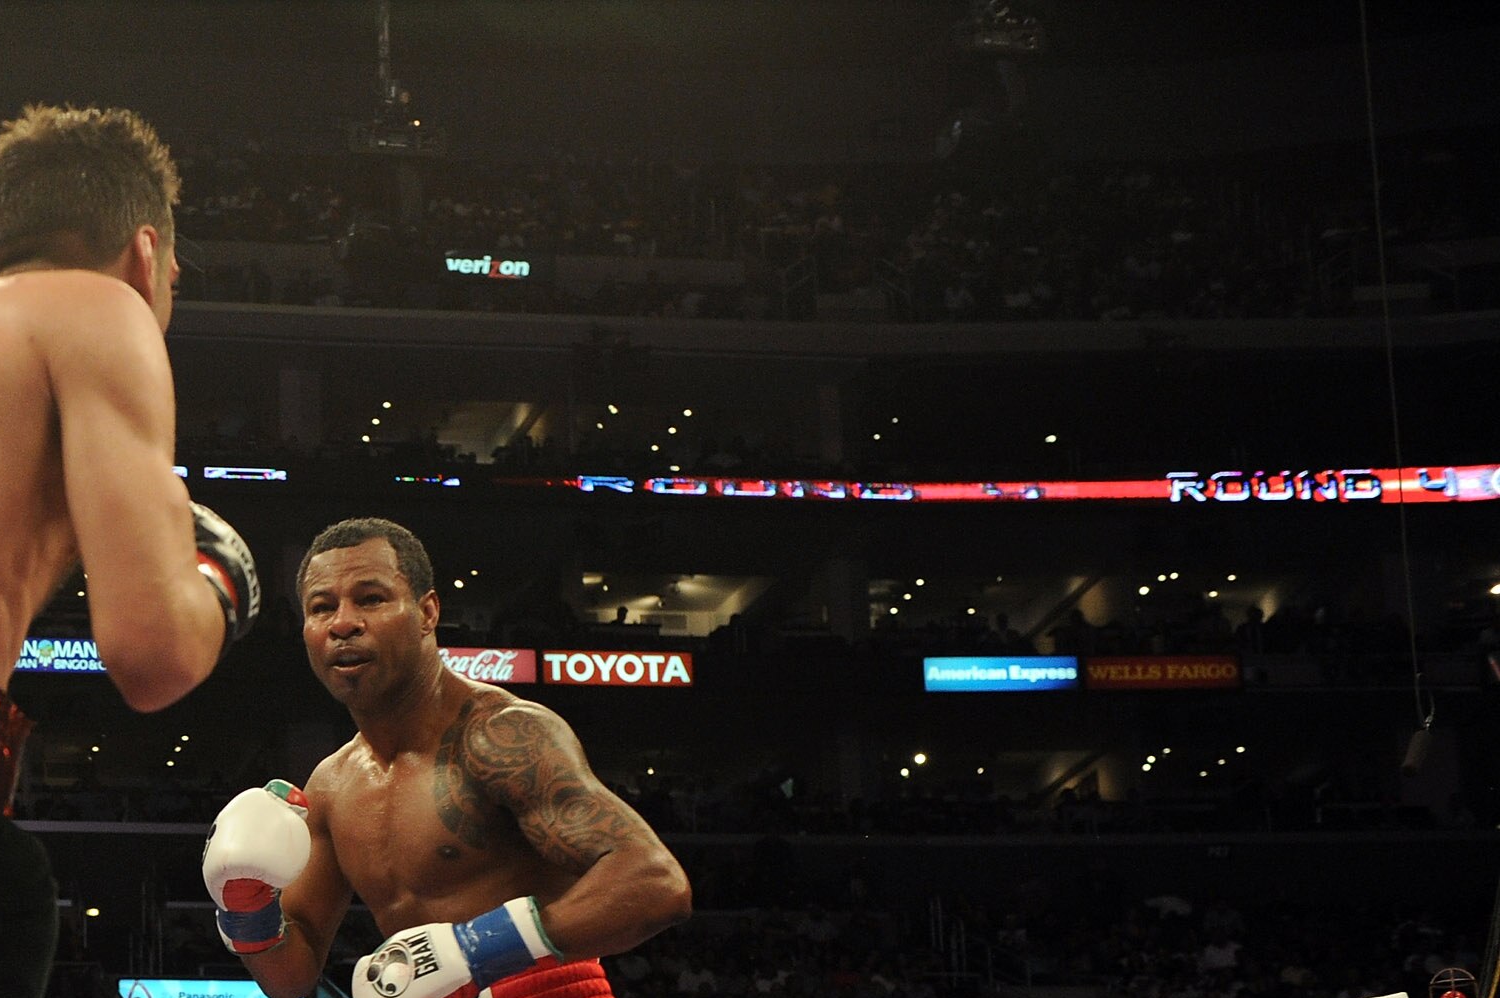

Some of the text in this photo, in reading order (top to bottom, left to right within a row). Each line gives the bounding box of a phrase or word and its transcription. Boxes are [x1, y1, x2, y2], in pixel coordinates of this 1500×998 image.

[446, 255, 530, 279] verizon
[1165, 470, 1382, 502] ROUND
[544, 653, 691, 683] TOYOTA
[928, 664, 1077, 683] American Express
[1088, 663, 1237, 681] WELLS FARGO
